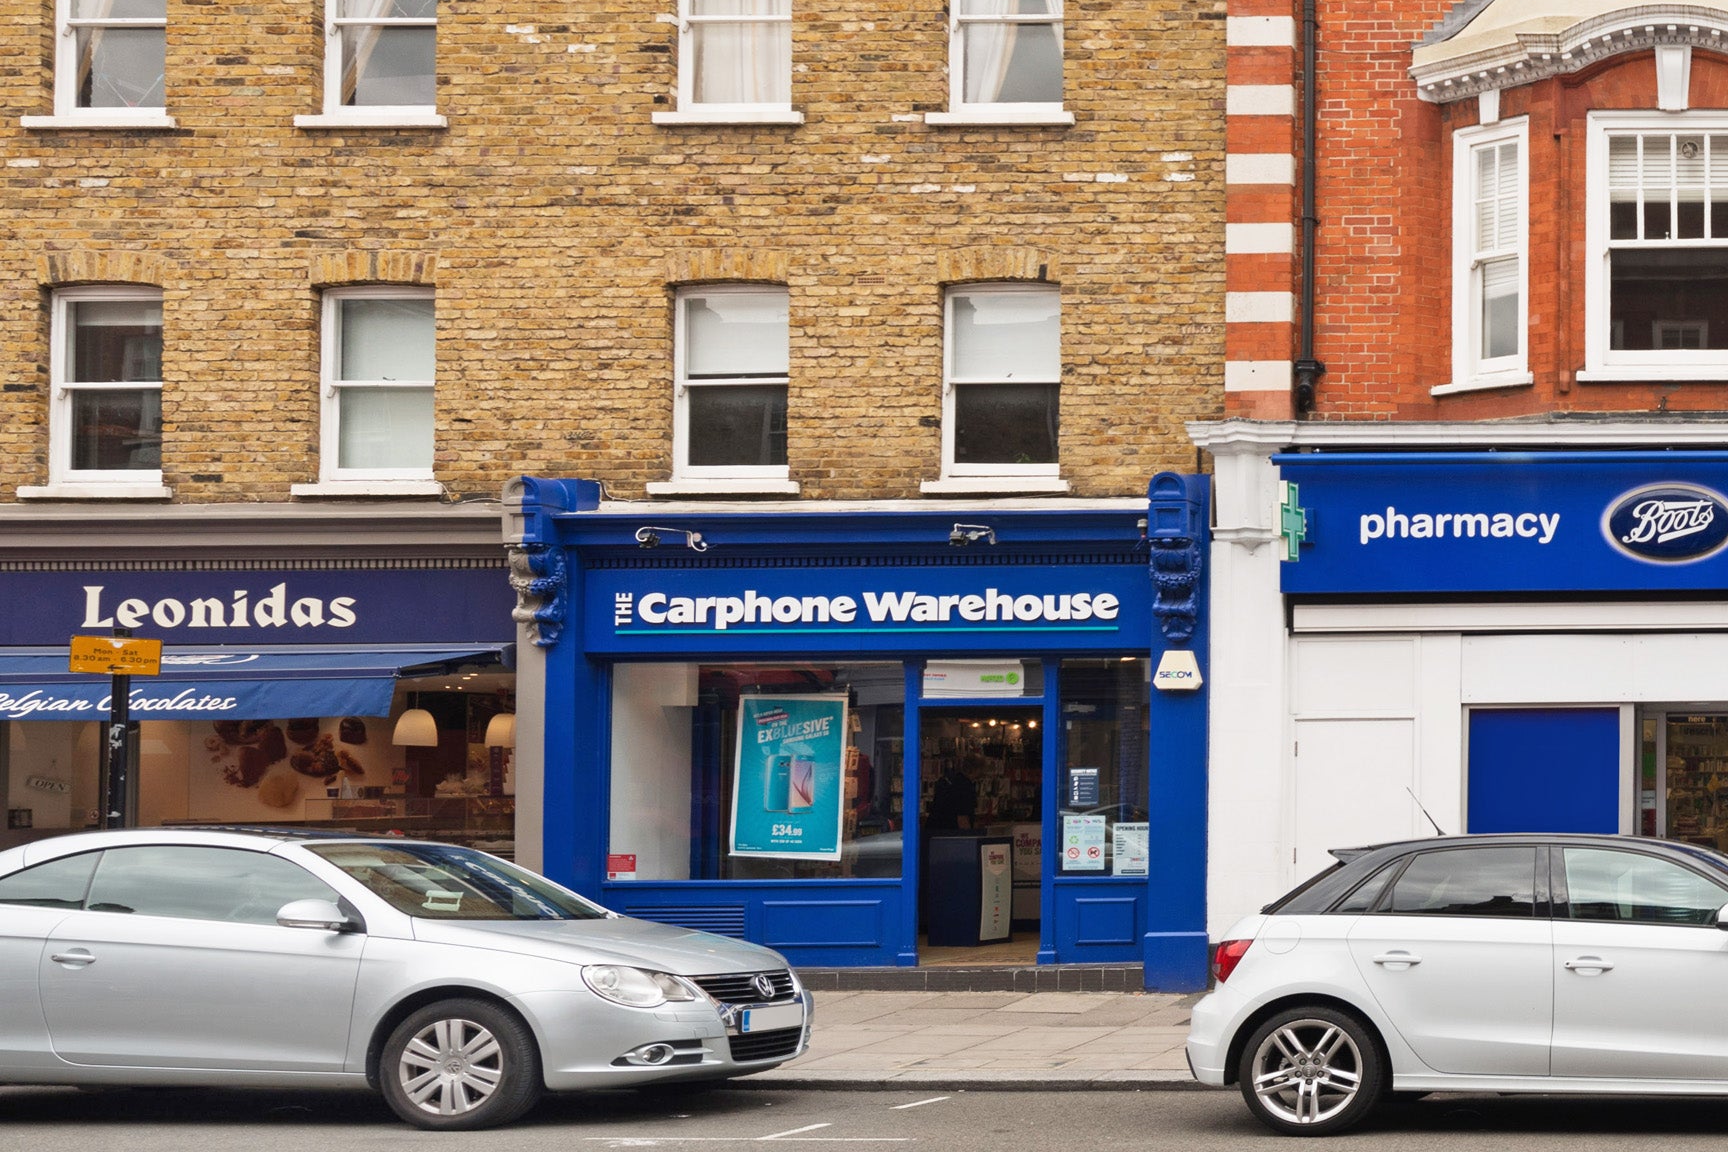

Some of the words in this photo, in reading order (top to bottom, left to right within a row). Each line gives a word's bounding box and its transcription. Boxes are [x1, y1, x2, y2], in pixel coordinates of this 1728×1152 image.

[1361, 507, 1559, 544] pharmacy
[1623, 500, 1713, 543] Boots
[82, 583, 355, 627] Leonidas
[615, 592, 633, 626] THE
[638, 591, 856, 629] Carphone
[863, 589, 1118, 621] Warehouse
[1159, 670, 1193, 679] SECOM
[97, 688, 238, 711] Cocolates
[35, 779, 65, 792] OPEN
[771, 823, 803, 837] £34.99
